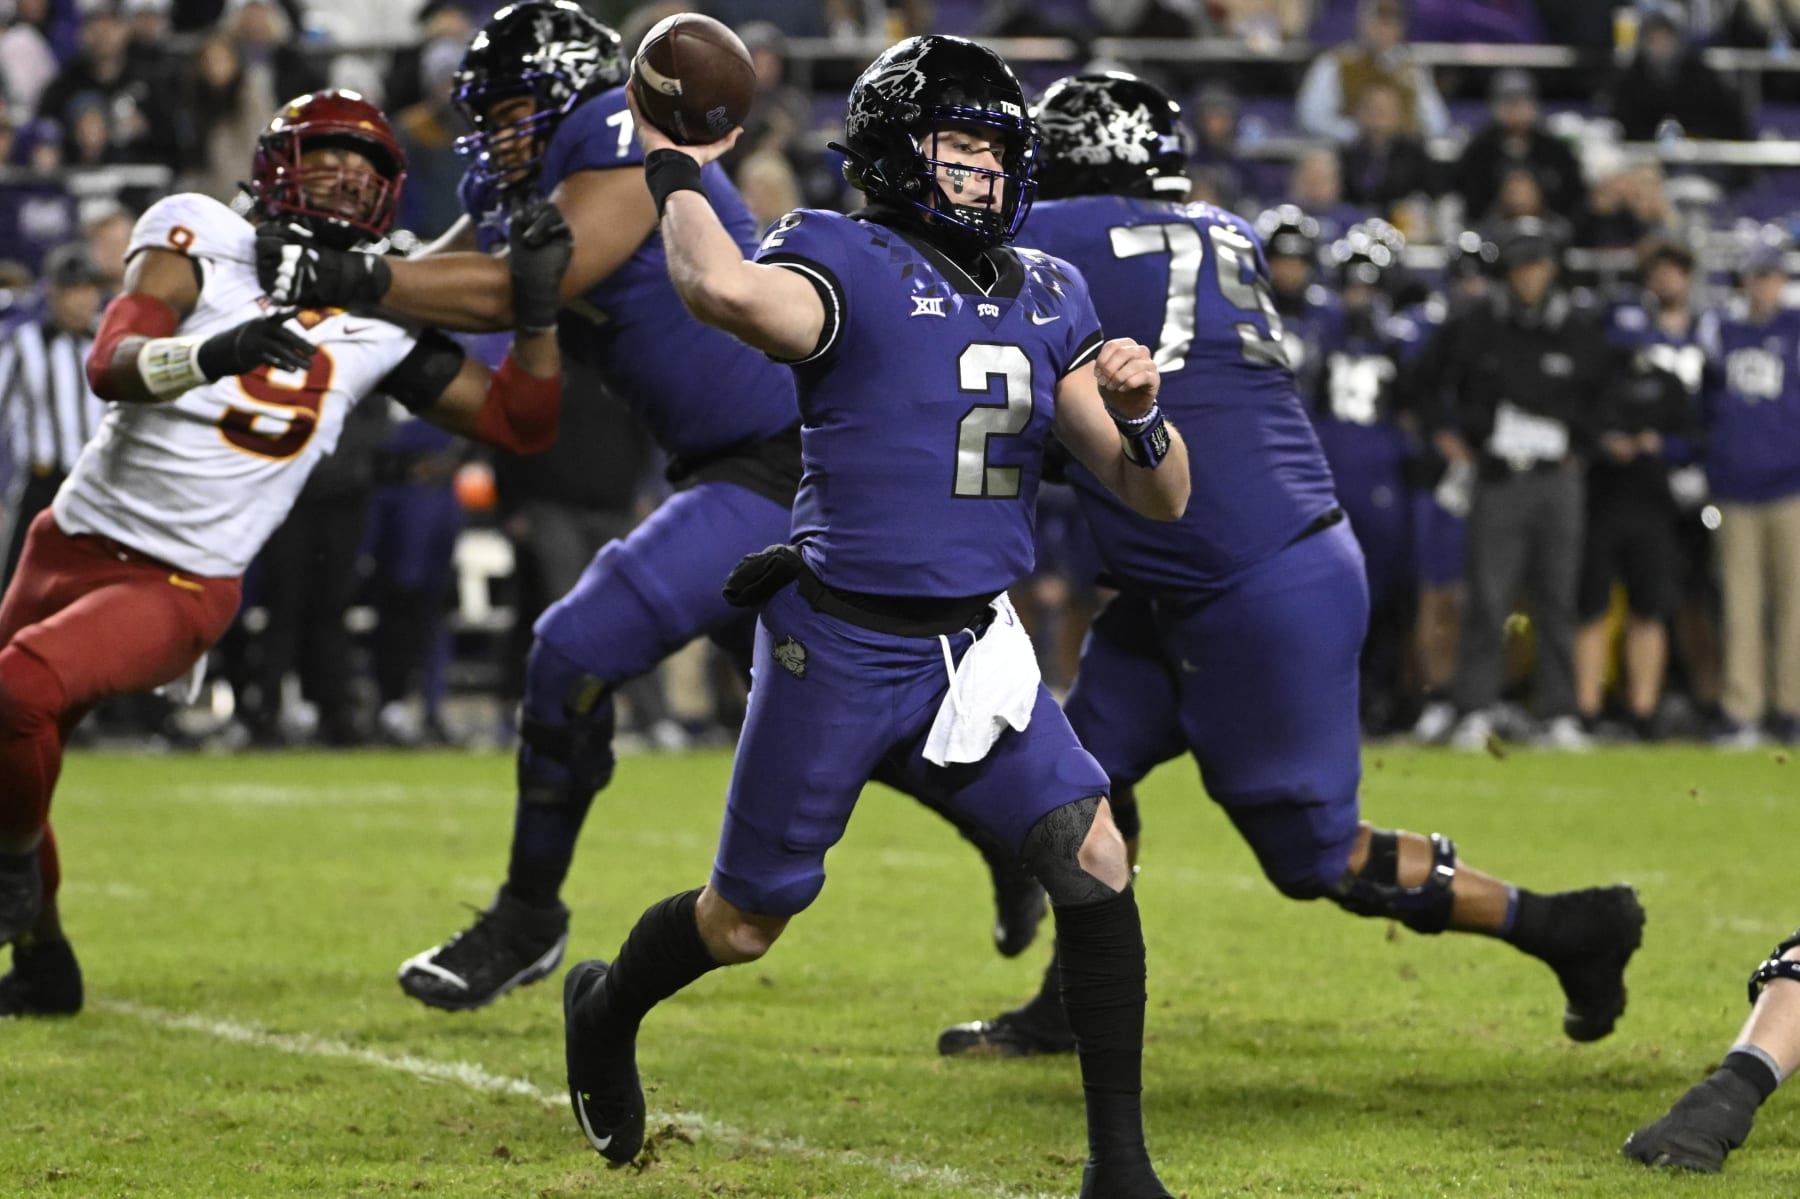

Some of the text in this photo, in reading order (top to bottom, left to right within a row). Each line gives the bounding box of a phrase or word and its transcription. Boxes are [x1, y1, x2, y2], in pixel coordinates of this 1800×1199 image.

[1000, 100, 1021, 118] TCU
[761, 212, 802, 251] 2
[910, 295, 946, 317] XII
[977, 303, 999, 317] TCU
[217, 344, 334, 461] 9
[953, 341, 1034, 498] 2
